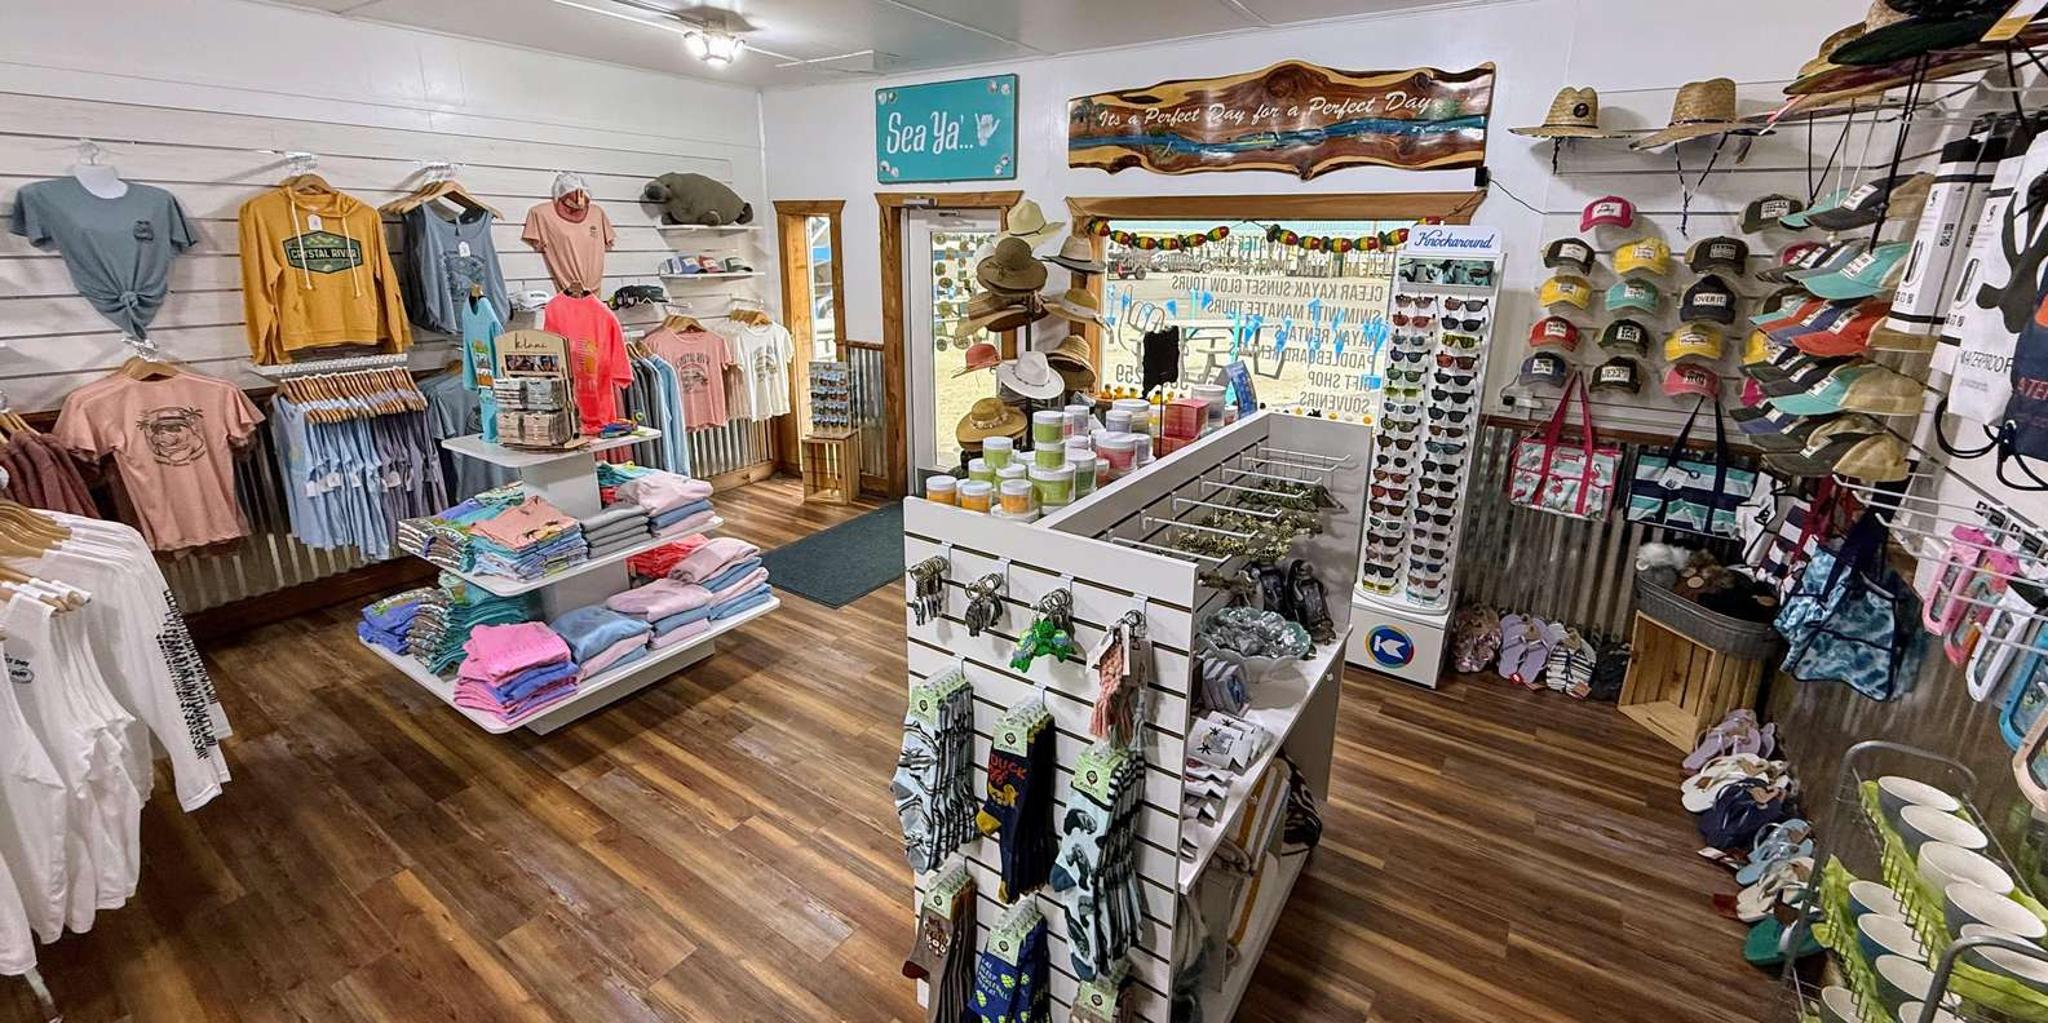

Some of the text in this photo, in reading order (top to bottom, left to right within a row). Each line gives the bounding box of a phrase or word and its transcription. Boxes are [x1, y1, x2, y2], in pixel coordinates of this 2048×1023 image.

[1100, 91, 1433, 128] Its a Perfect Day for a Perfect Day
[887, 111, 926, 154] Sea
[1414, 229, 1495, 249] Knockaround
